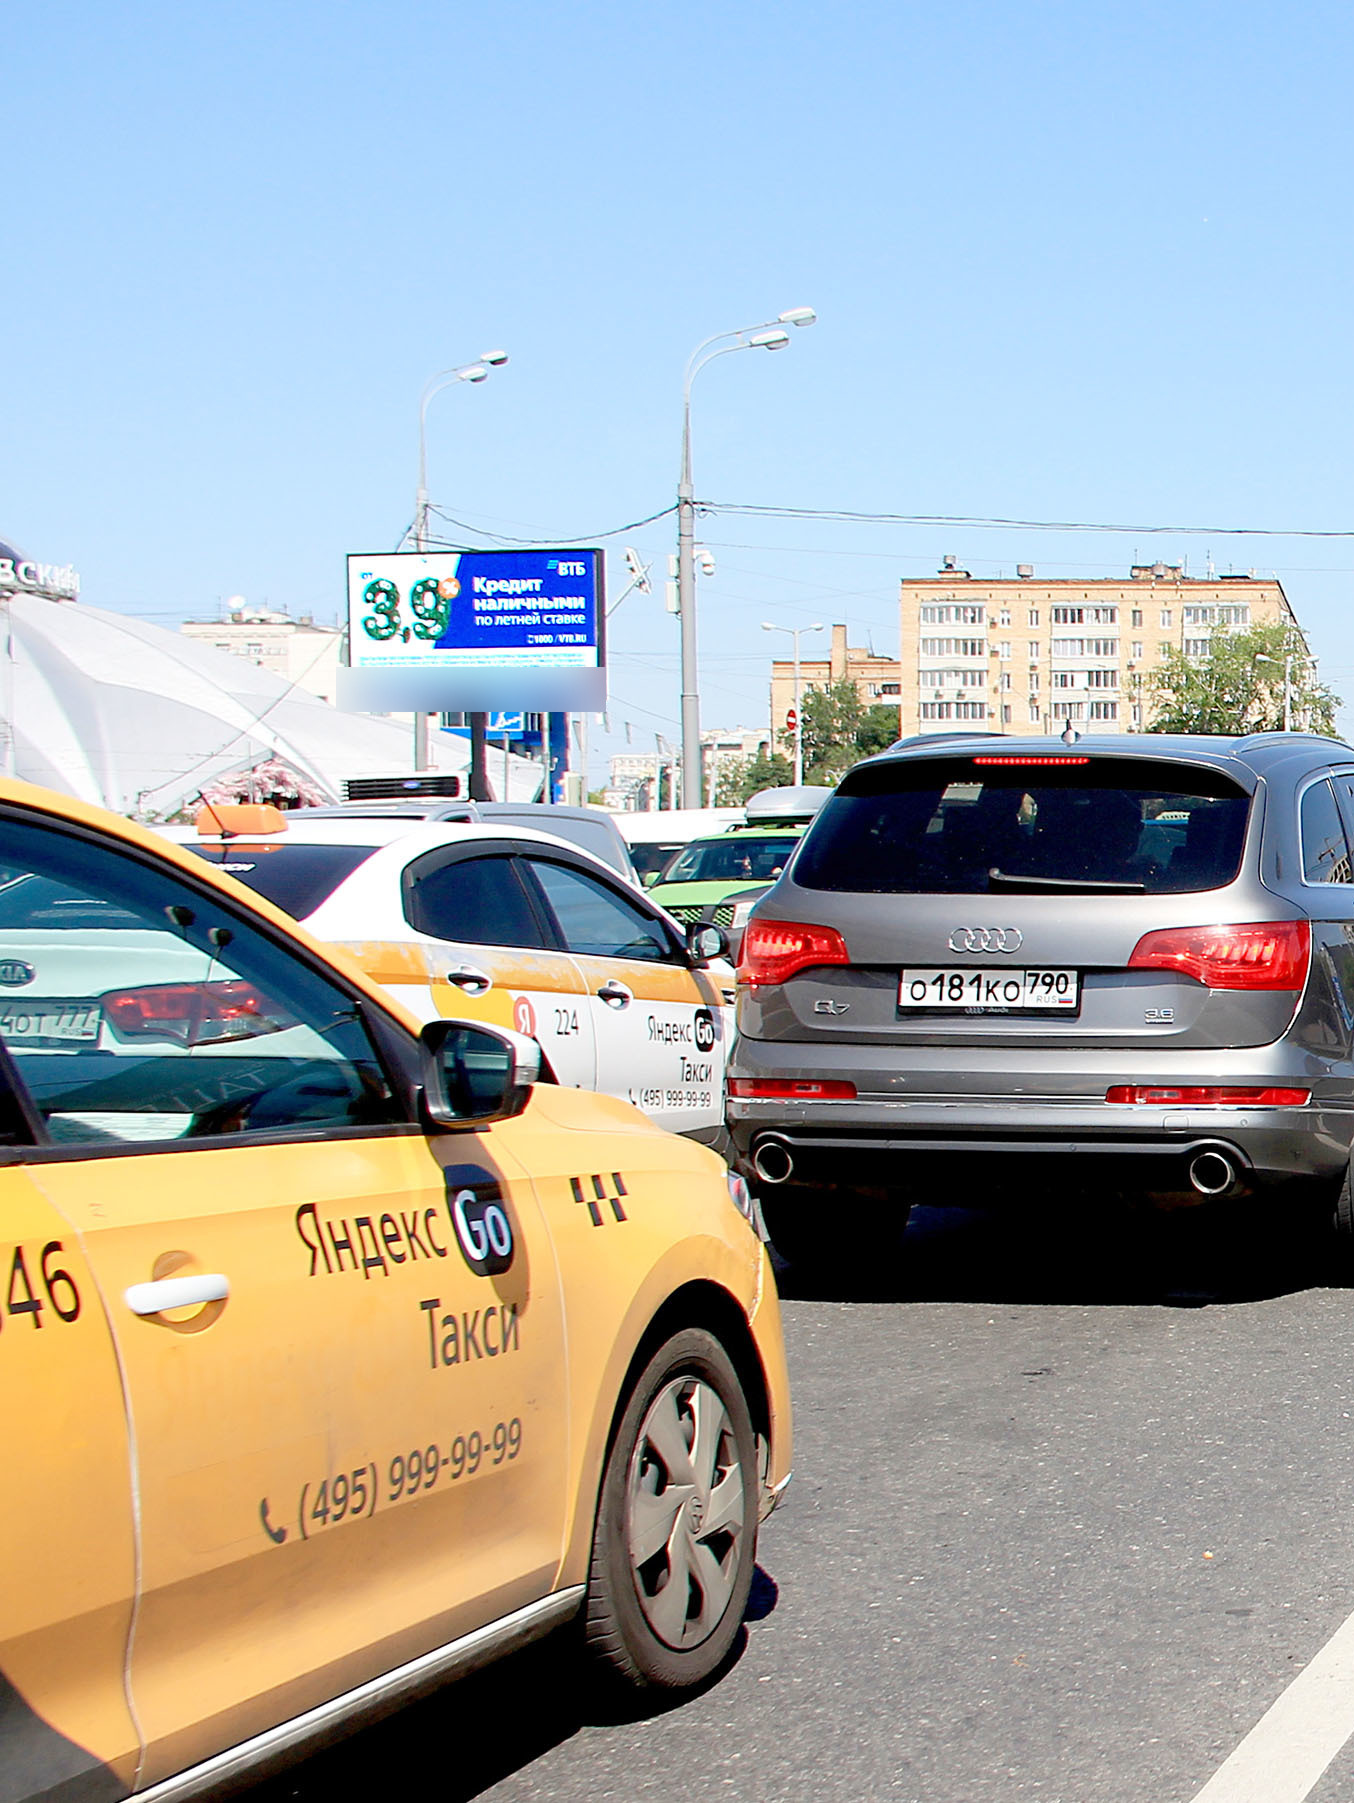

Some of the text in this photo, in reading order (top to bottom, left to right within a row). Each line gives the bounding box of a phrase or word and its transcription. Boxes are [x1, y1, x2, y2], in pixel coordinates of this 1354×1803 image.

[558, 561, 585, 576] ВТБ
[474, 576, 543, 596] Кредит
[474, 597, 585, 611] наличными
[475, 612, 586, 625] по летней ставке
[1027, 972, 1069, 995] 790
[814, 999, 850, 1015] Q7
[1036, 995, 1057, 1004] RUS
[554, 1009, 579, 1036] 224
[648, 1015, 714, 1046] Яндекс Go
[680, 1056, 713, 1083] Такси
[639, 1088, 712, 1108] (495) 999-99-99
[296, 1189, 513, 1280] Яндекс Go
[0, 1240, 80, 1330] 46
[420, 1298, 520, 1369] Такси
[299, 1417, 523, 1541] (495) 999-99-99
